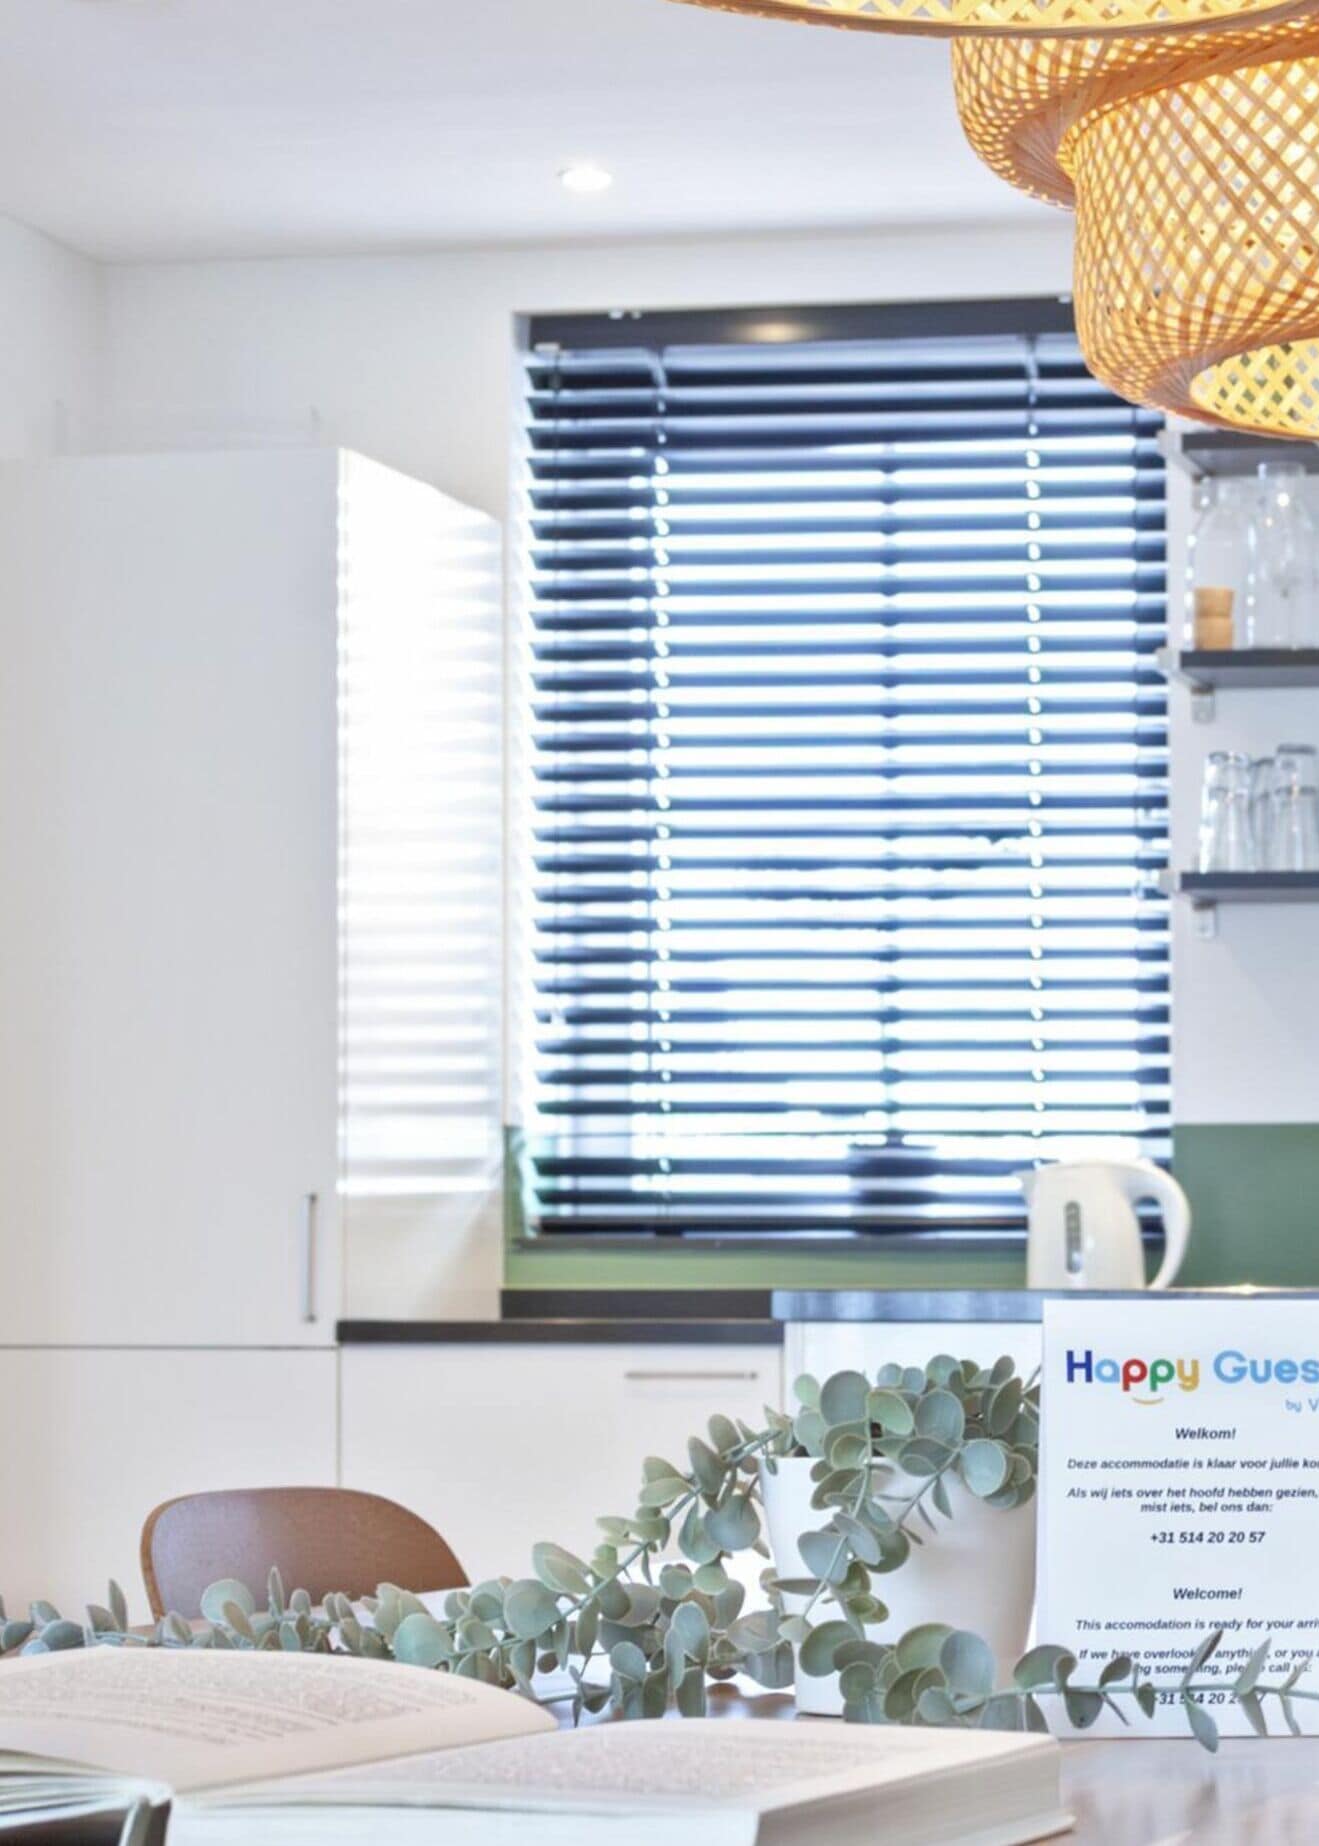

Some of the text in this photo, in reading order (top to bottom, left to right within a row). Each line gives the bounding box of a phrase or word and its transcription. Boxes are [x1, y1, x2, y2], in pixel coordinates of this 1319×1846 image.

[1066, 1350, 1199, 1392] Happy
[1175, 1427, 1236, 1440] Welkom!
[1066, 1458, 1097, 1469] Deze
[1193, 1458, 1204, 1469] is
[1207, 1458, 1237, 1469] klaar
[1240, 1459, 1268, 1469] voor
[1269, 1458, 1300, 1471] jullie
[1066, 1488, 1087, 1498] Als
[1090, 1488, 1108, 1500] wij
[1111, 1488, 1133, 1498] iets
[1136, 1489, 1163, 1498] over
[1166, 1487, 1187, 1498] het
[1189, 1487, 1225, 1498] hoofd
[1228, 1487, 1273, 1498] hebben
[1276, 1488, 1318, 1500] gezien,
[1140, 1501, 1273, 1513] mist iets, bel ons dan:
[1151, 1531, 1266, 1544] +31 514 20 20 57
[1173, 1587, 1243, 1600] Welcome!
[1075, 1620, 1101, 1630] This
[1104, 1619, 1192, 1630] accomodation
[1195, 1618, 1206, 1629] is
[1208, 1618, 1243, 1633] ready
[1246, 1618, 1264, 1629] for
[1266, 1619, 1294, 1632] your
[1078, 1649, 1088, 1659] If
[1090, 1650, 1108, 1659] we
[1274, 1649, 1288, 1657] or
[1291, 1649, 1313, 1660] you
[1269, 1663, 1291, 1673] call
[1208, 1692, 1226, 1704] 20
